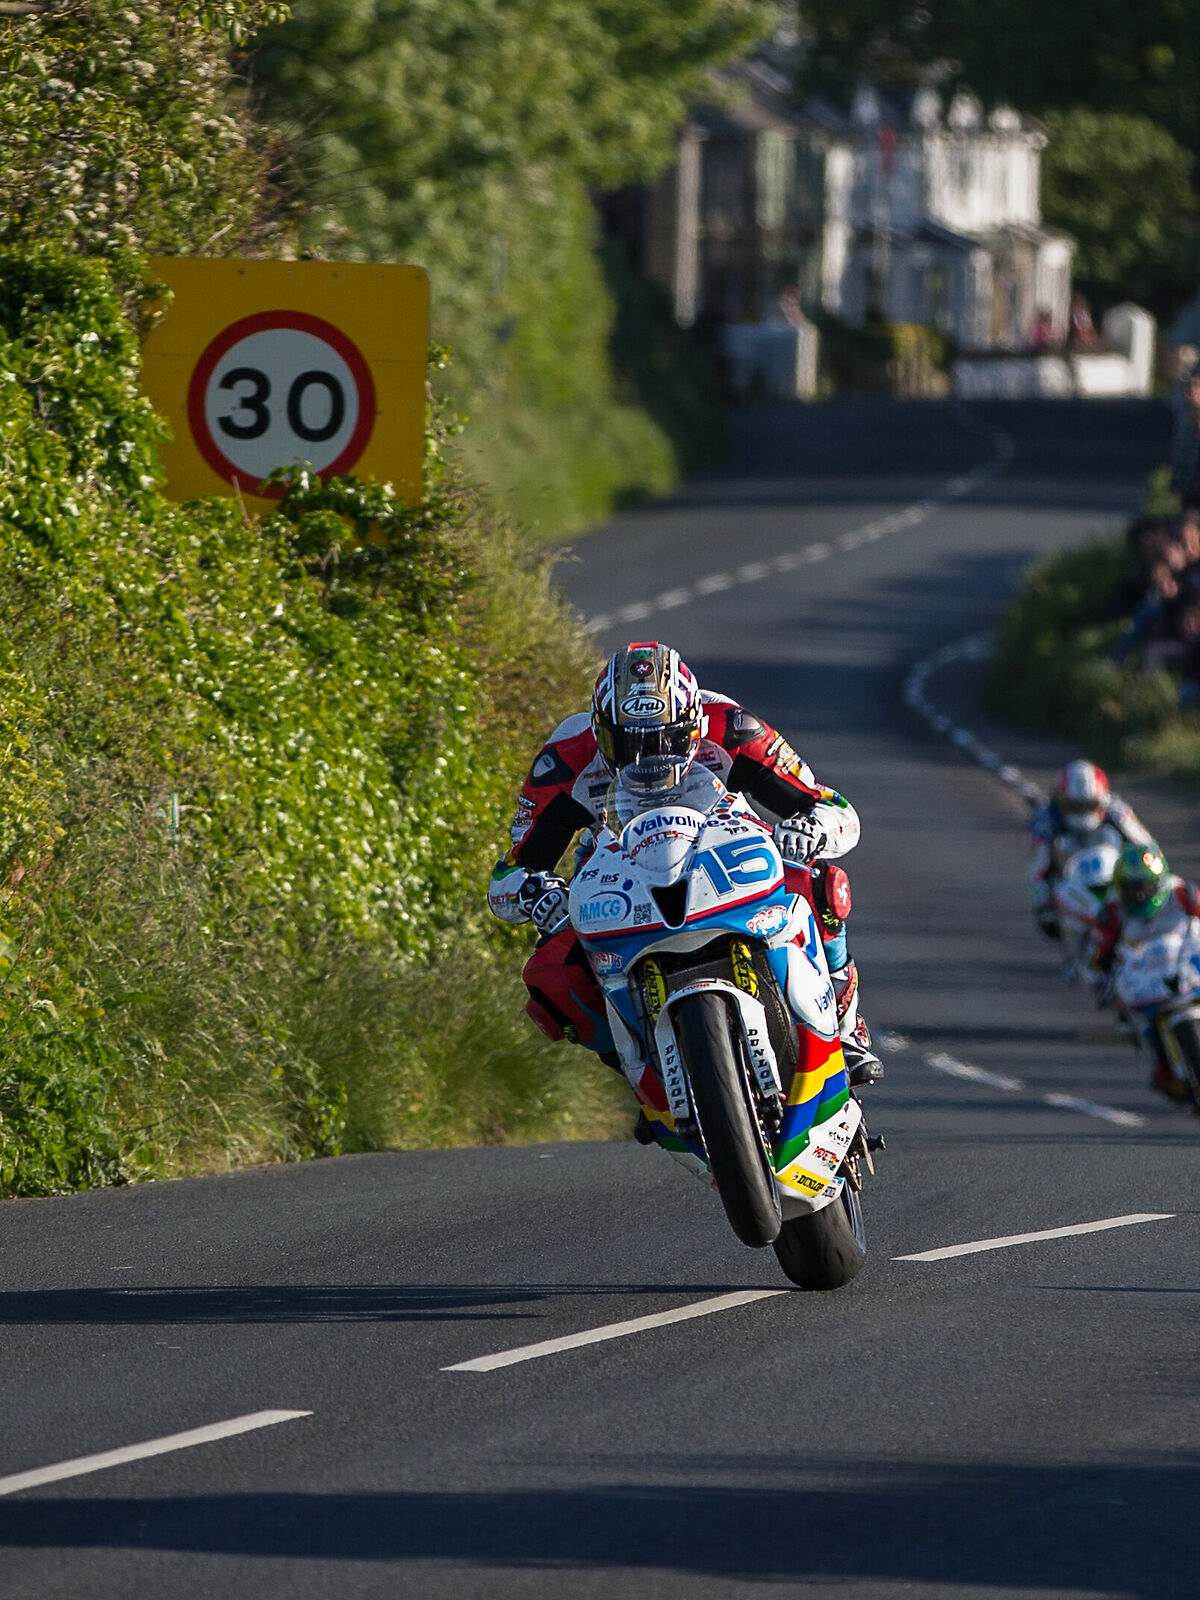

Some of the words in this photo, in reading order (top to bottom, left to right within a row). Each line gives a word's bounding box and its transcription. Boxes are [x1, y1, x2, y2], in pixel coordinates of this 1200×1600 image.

[217, 366, 345, 443] 30
[625, 700, 660, 712] Arai
[633, 815, 719, 836] Valvoline
[688, 836, 777, 896] 15
[579, 899, 621, 921] MMCG
[664, 1044, 686, 1110] DUNLOP
[749, 1028, 776, 1091] DUNLOP
[797, 1174, 825, 1192] DUNLOP
